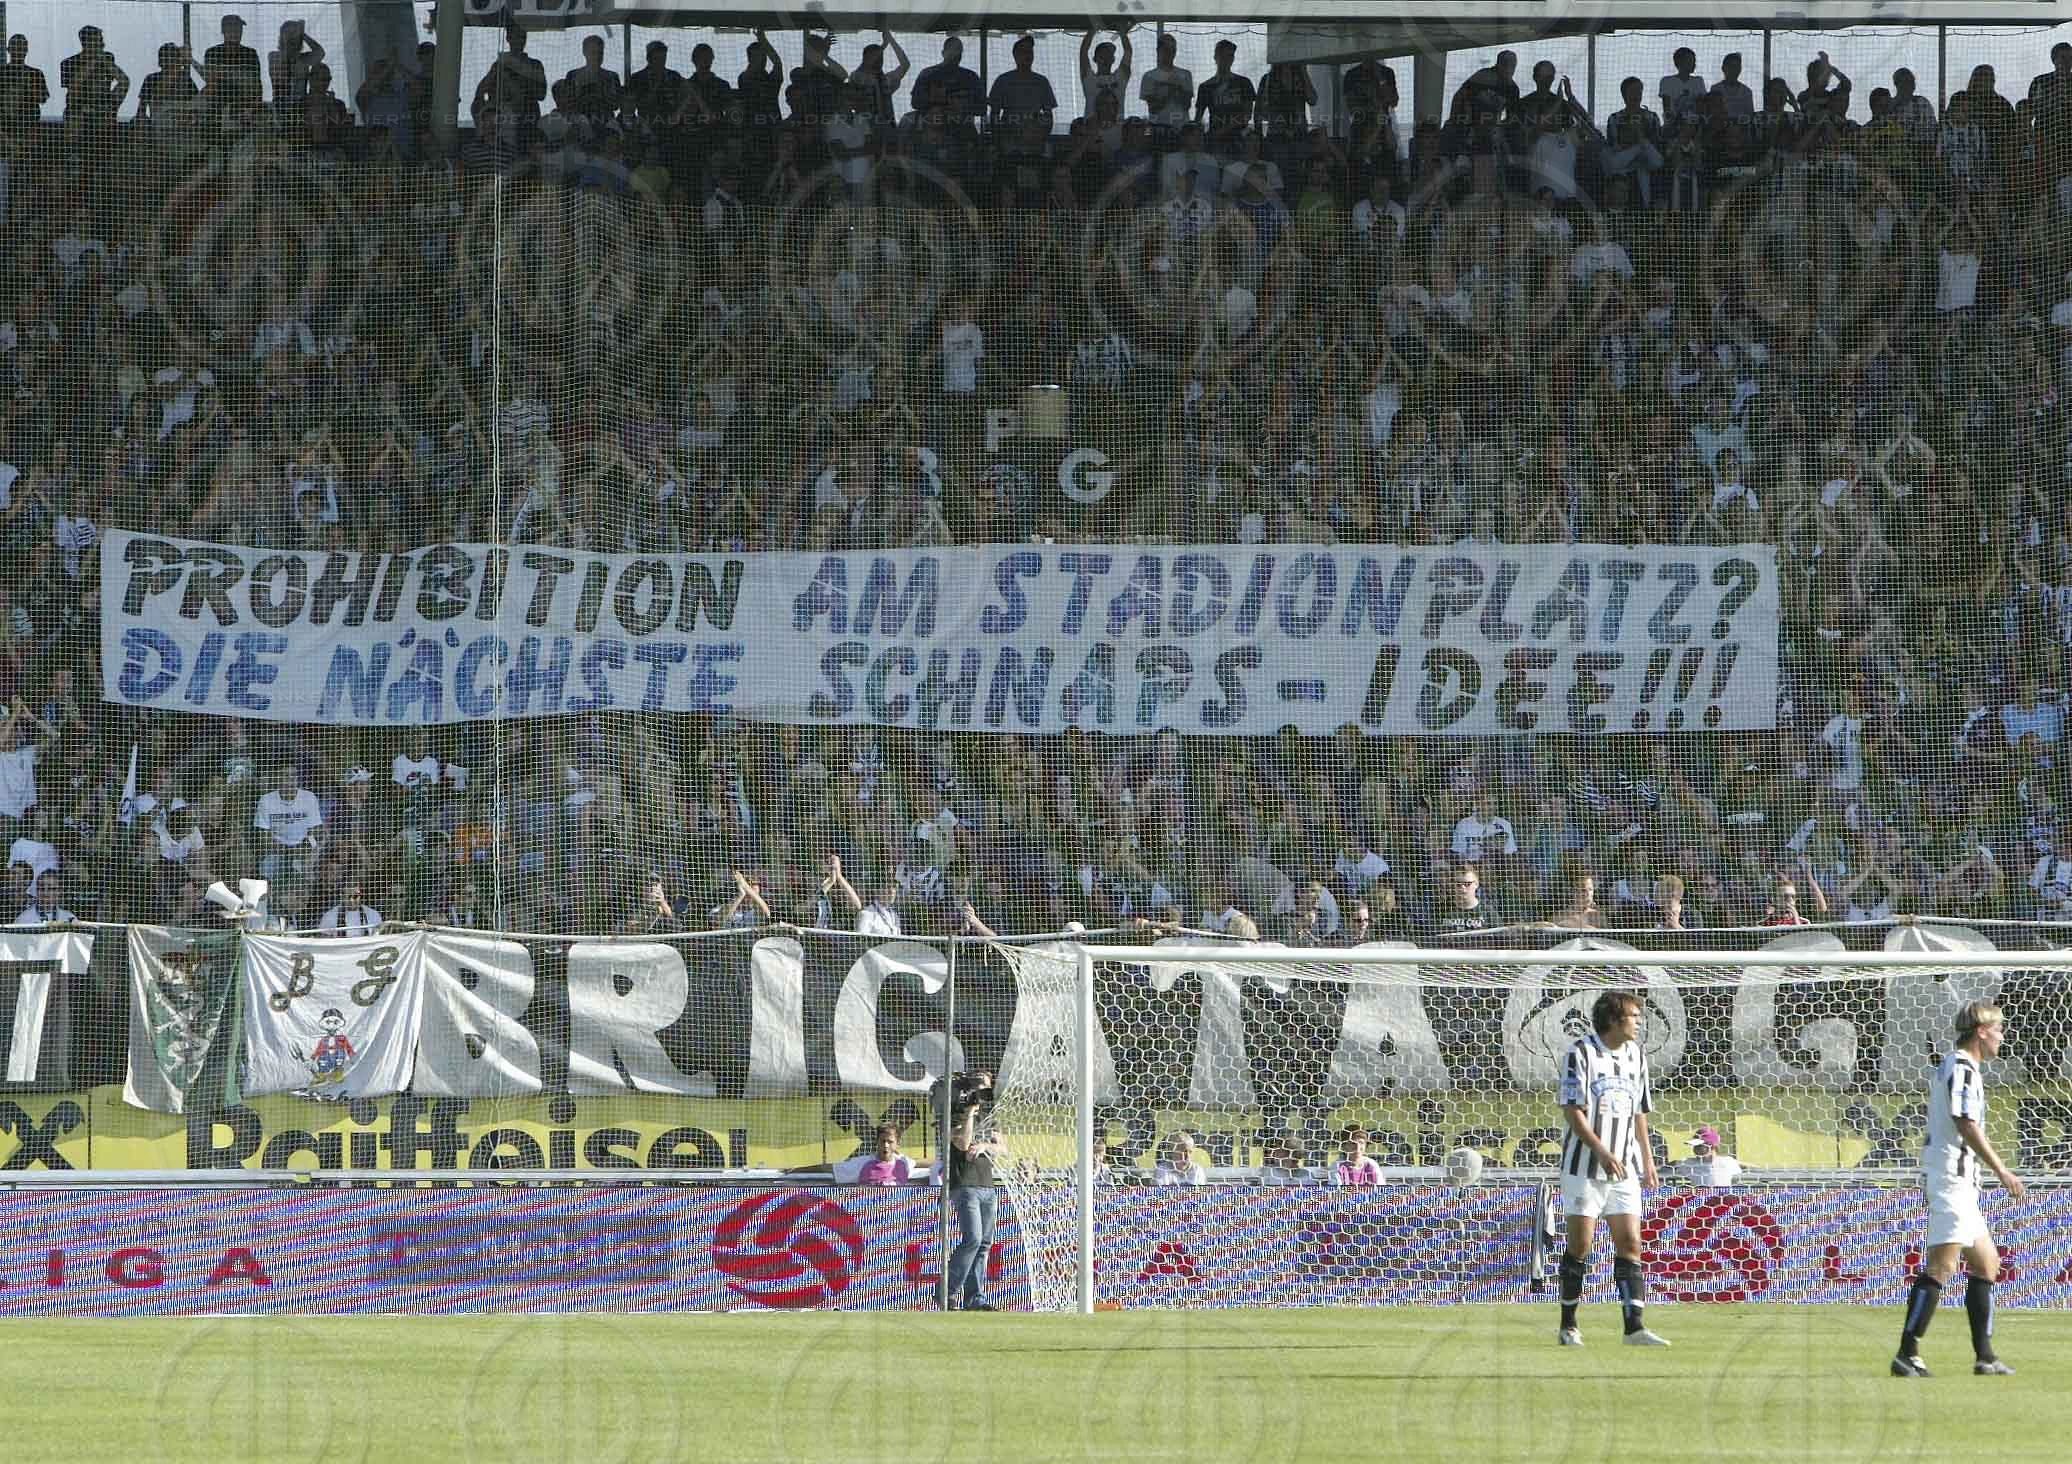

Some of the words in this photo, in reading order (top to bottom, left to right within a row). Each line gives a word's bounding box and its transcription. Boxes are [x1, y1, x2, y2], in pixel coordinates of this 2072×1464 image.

[1058, 447, 1119, 504] G
[121, 536, 745, 637] PROHIBITION
[792, 555, 940, 640] AM
[979, 551, 1761, 643] STADIONPLATZ?
[117, 626, 290, 712] DIE
[317, 626, 745, 722] NÄCHSTE
[415, 936, 1457, 1106] BRIGATA
[0, 1246, 273, 1289] IGA
[904, 1242, 1203, 1285] LIA
